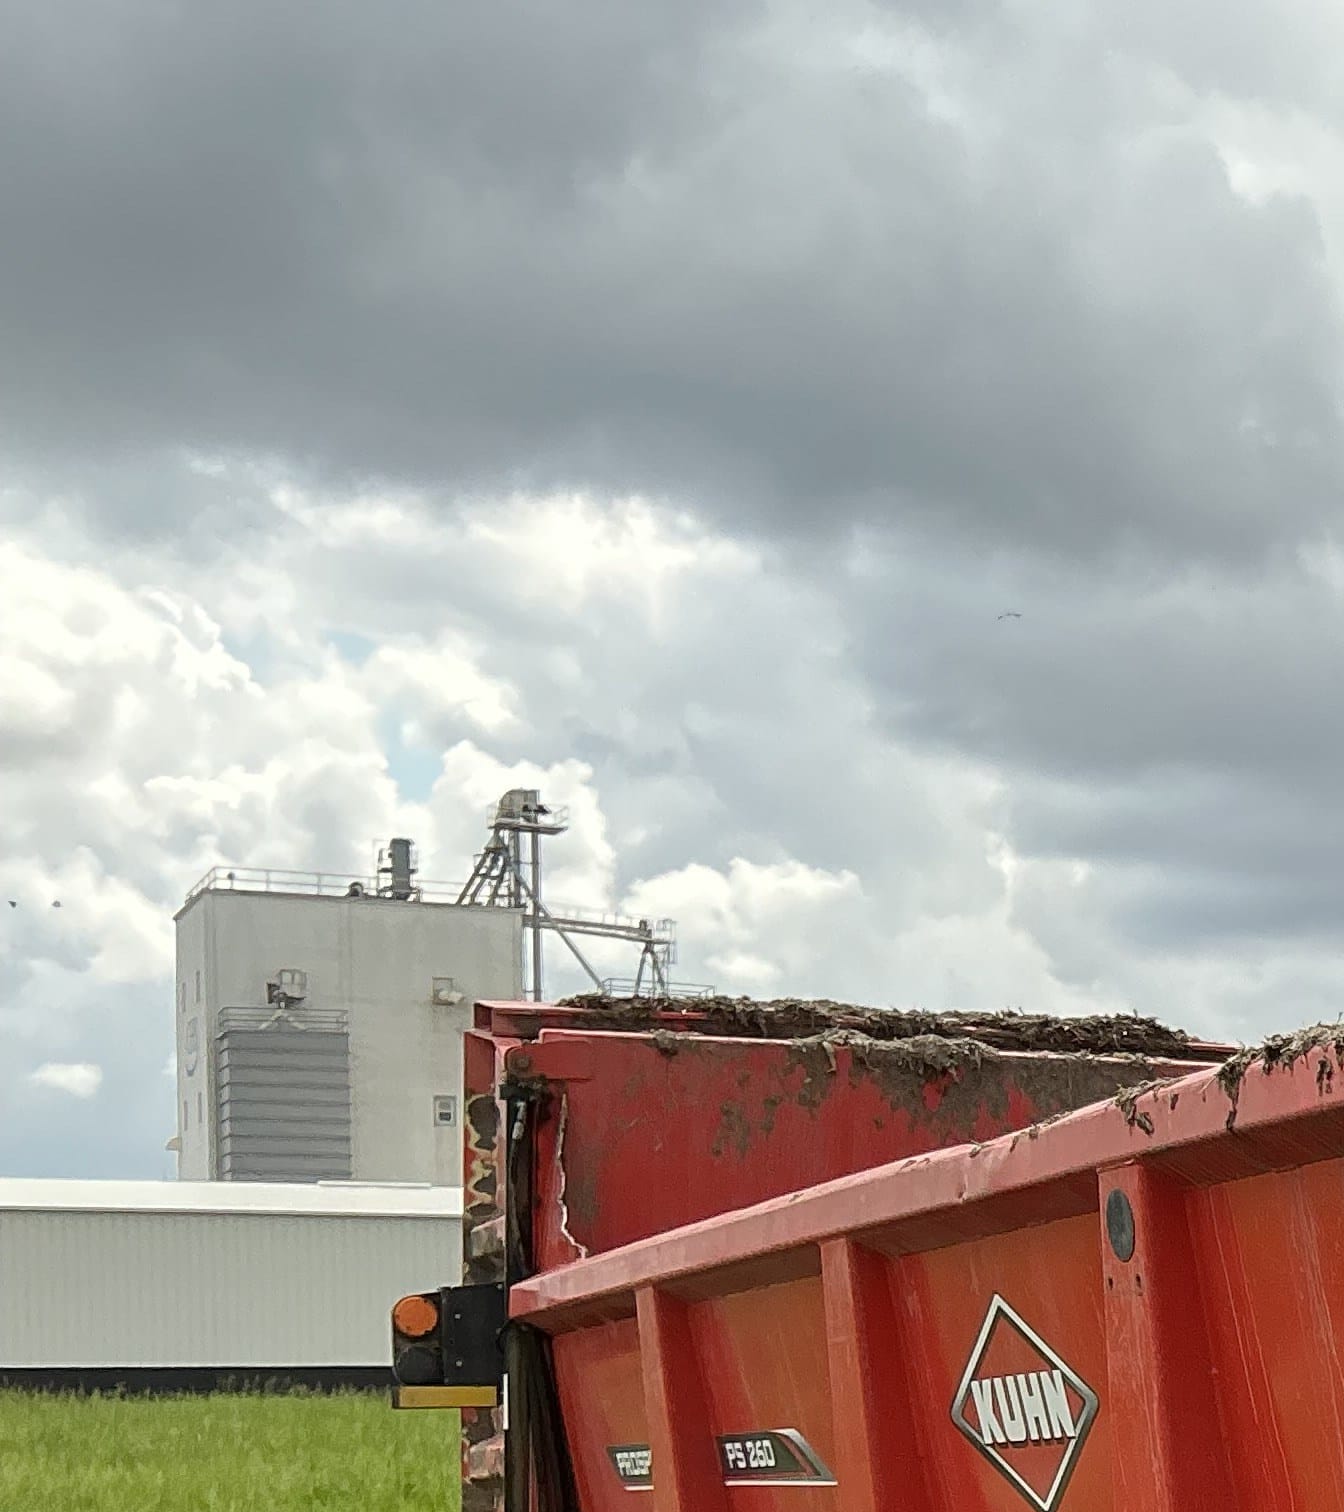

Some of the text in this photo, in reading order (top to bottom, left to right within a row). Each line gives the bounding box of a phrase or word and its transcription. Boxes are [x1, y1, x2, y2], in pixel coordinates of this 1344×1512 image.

[971, 1370, 1076, 1444] KUHN
[725, 1439, 776, 1469] PS 260
